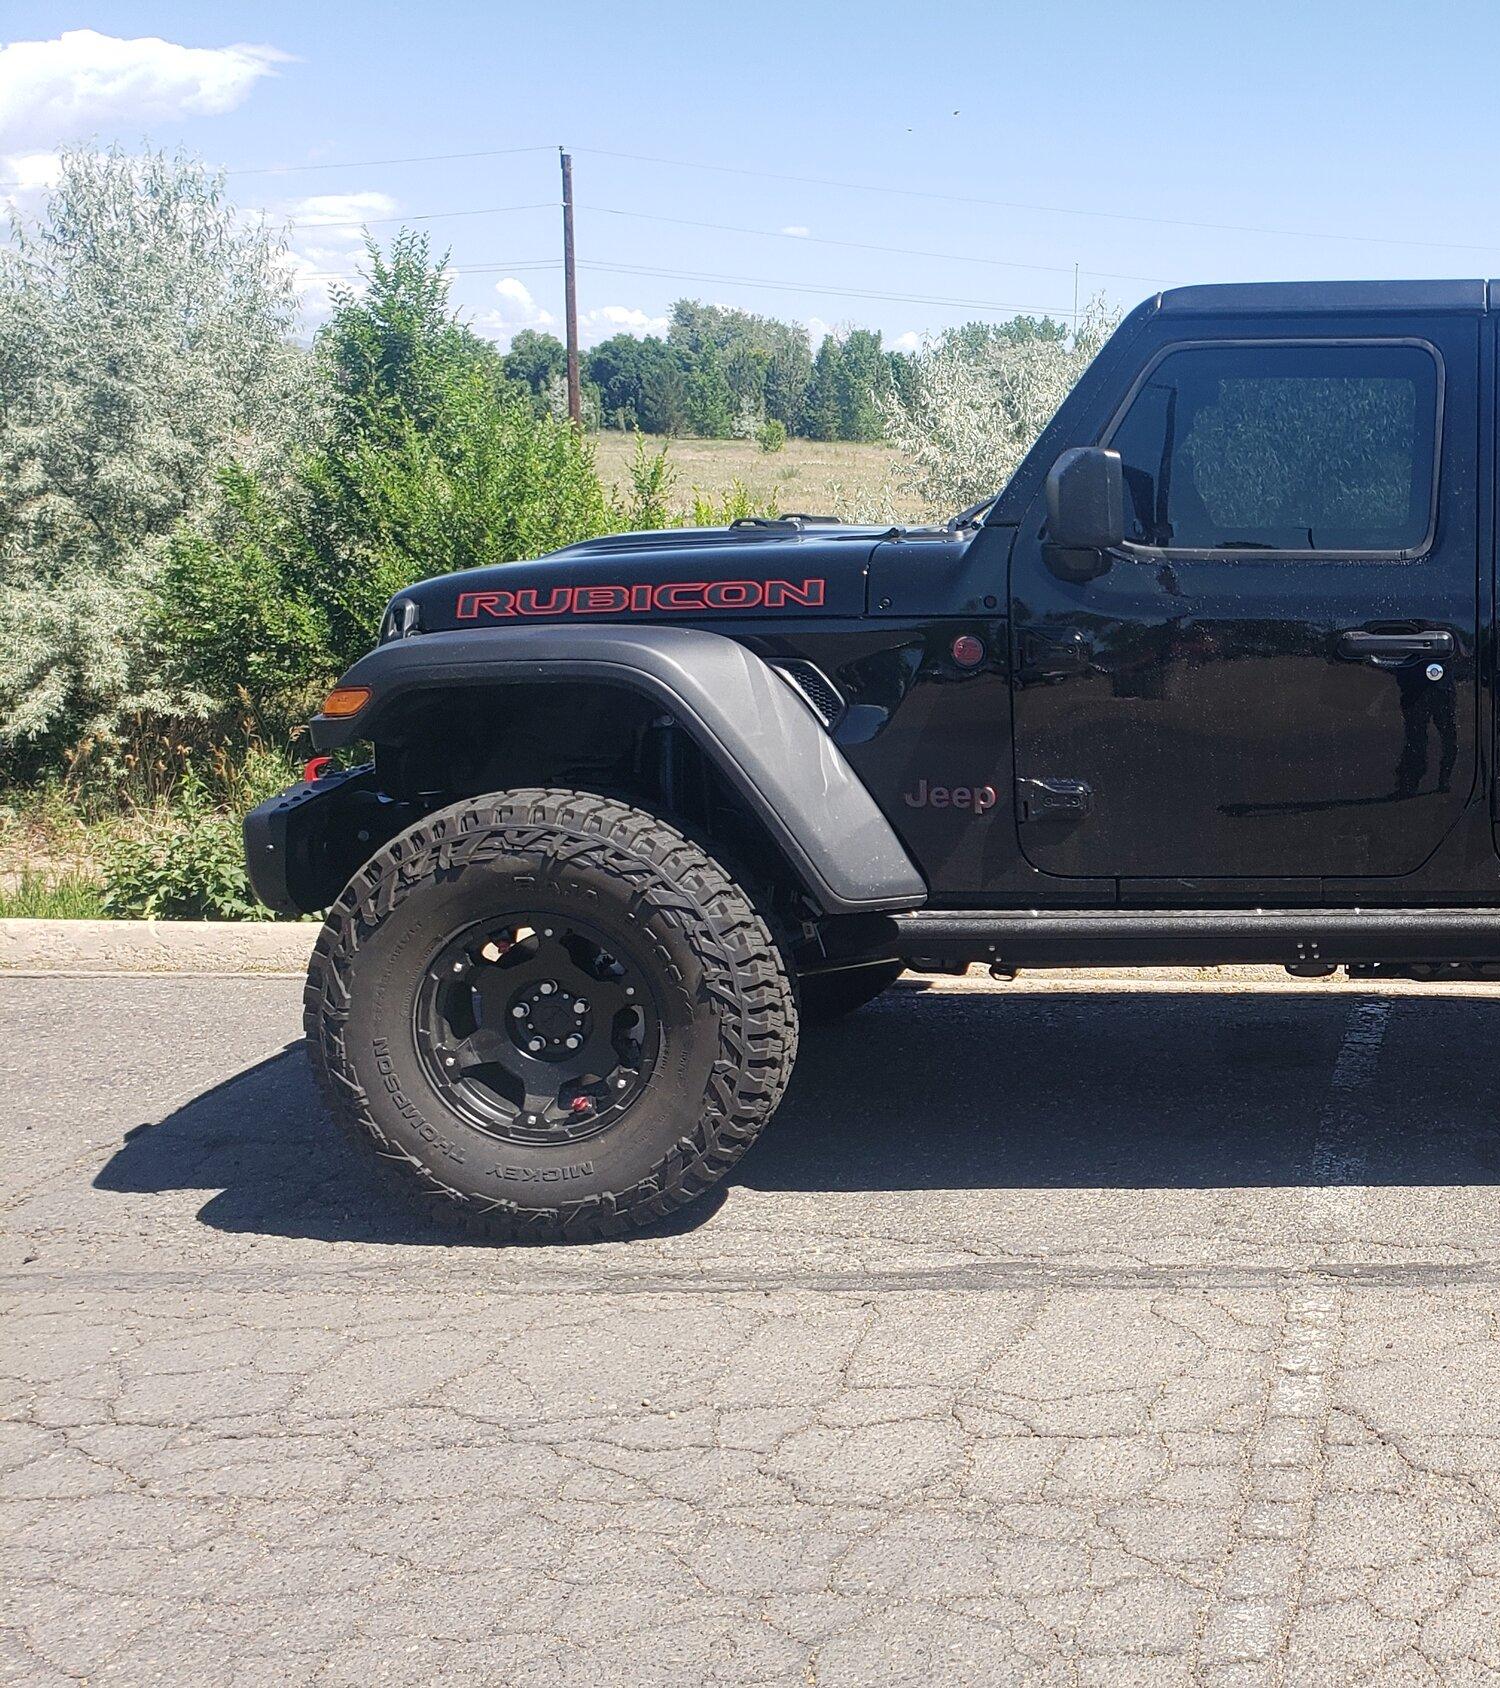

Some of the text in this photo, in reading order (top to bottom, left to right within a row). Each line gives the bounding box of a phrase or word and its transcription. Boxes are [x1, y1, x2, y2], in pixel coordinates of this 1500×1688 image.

[456, 579, 827, 619] RUBICON
[904, 779, 997, 814] Jeep
[373, 1037, 594, 1185] MICKEY THOMPSON
